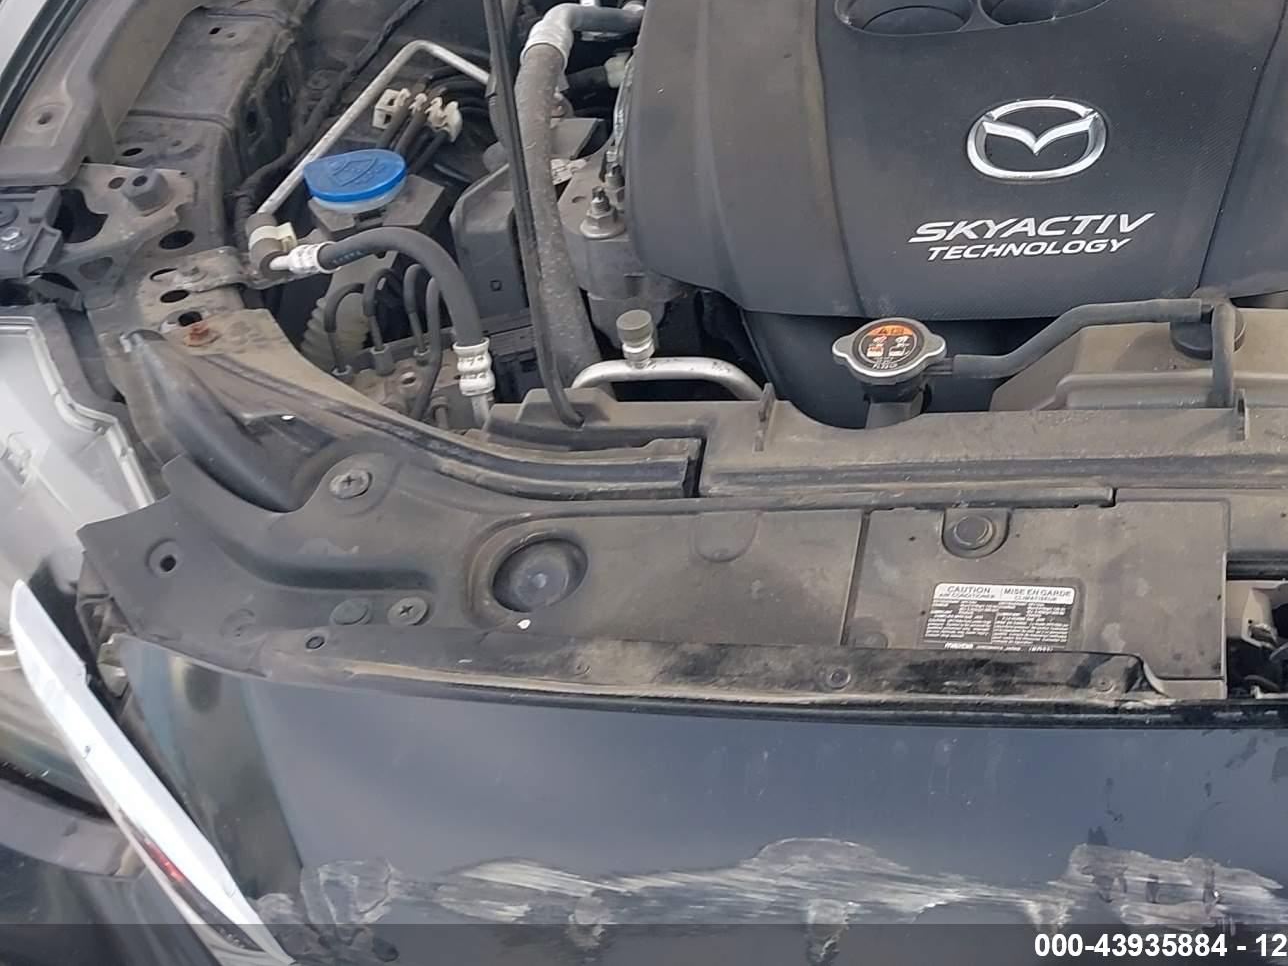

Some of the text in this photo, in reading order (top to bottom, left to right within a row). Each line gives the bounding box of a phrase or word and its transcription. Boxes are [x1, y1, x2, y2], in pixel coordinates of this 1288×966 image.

[908, 212, 1156, 243] SKYACTIV
[927, 238, 1132, 261] TECHNOLOGY
[947, 585, 991, 594] CAUTION
[1003, 588, 1072, 597] MISE EN GARDE
